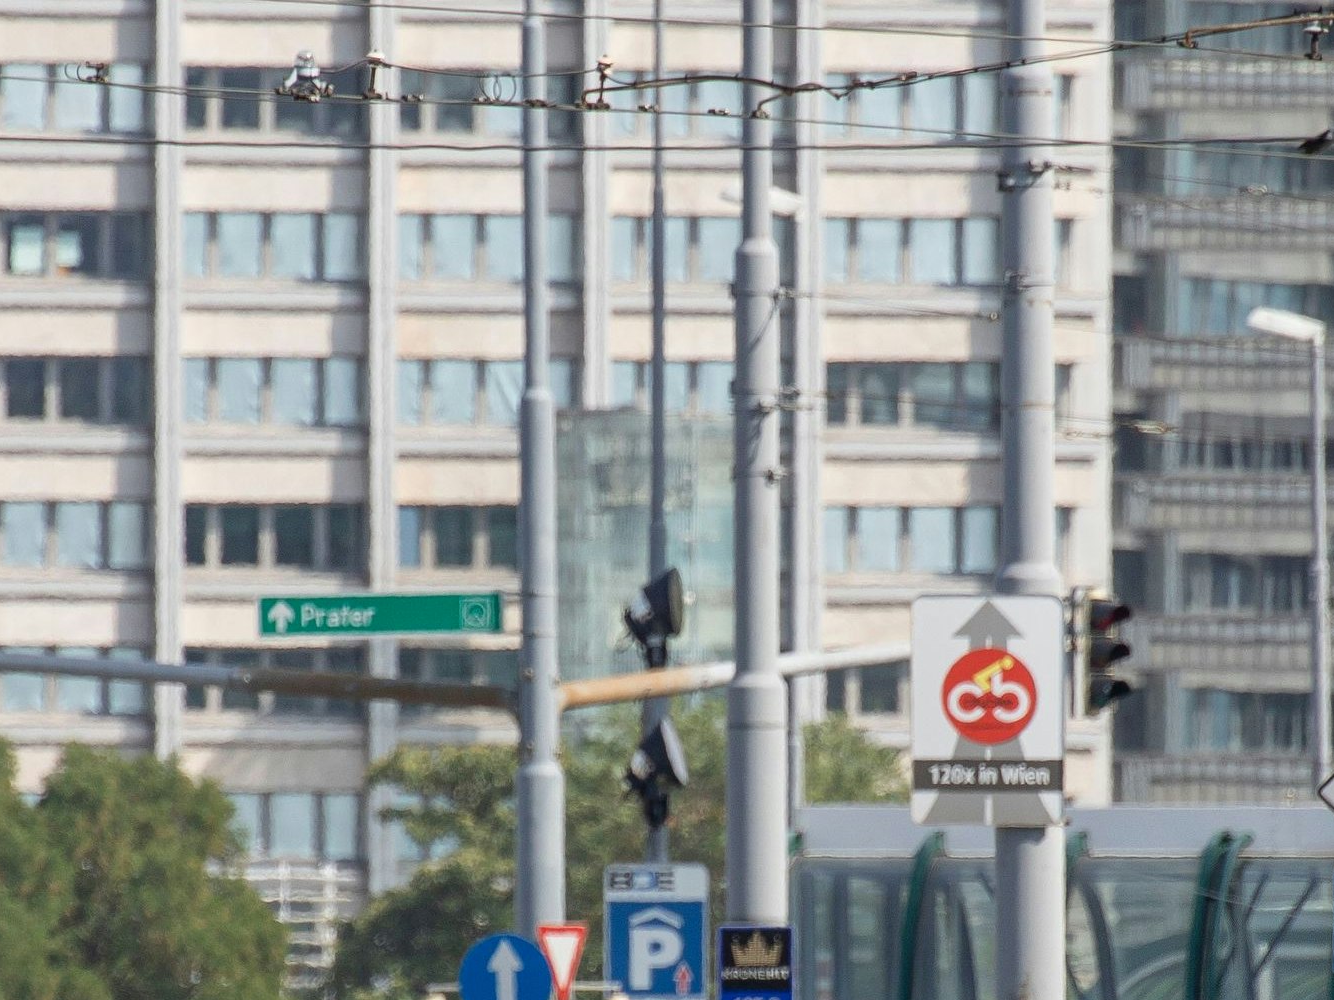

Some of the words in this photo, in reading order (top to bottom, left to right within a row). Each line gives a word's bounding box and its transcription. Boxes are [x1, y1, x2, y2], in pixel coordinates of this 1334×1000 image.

[300, 602, 376, 628] Prater
[929, 763, 975, 785] 120x
[978, 762, 998, 785] in
[1001, 762, 1050, 785] Wien
